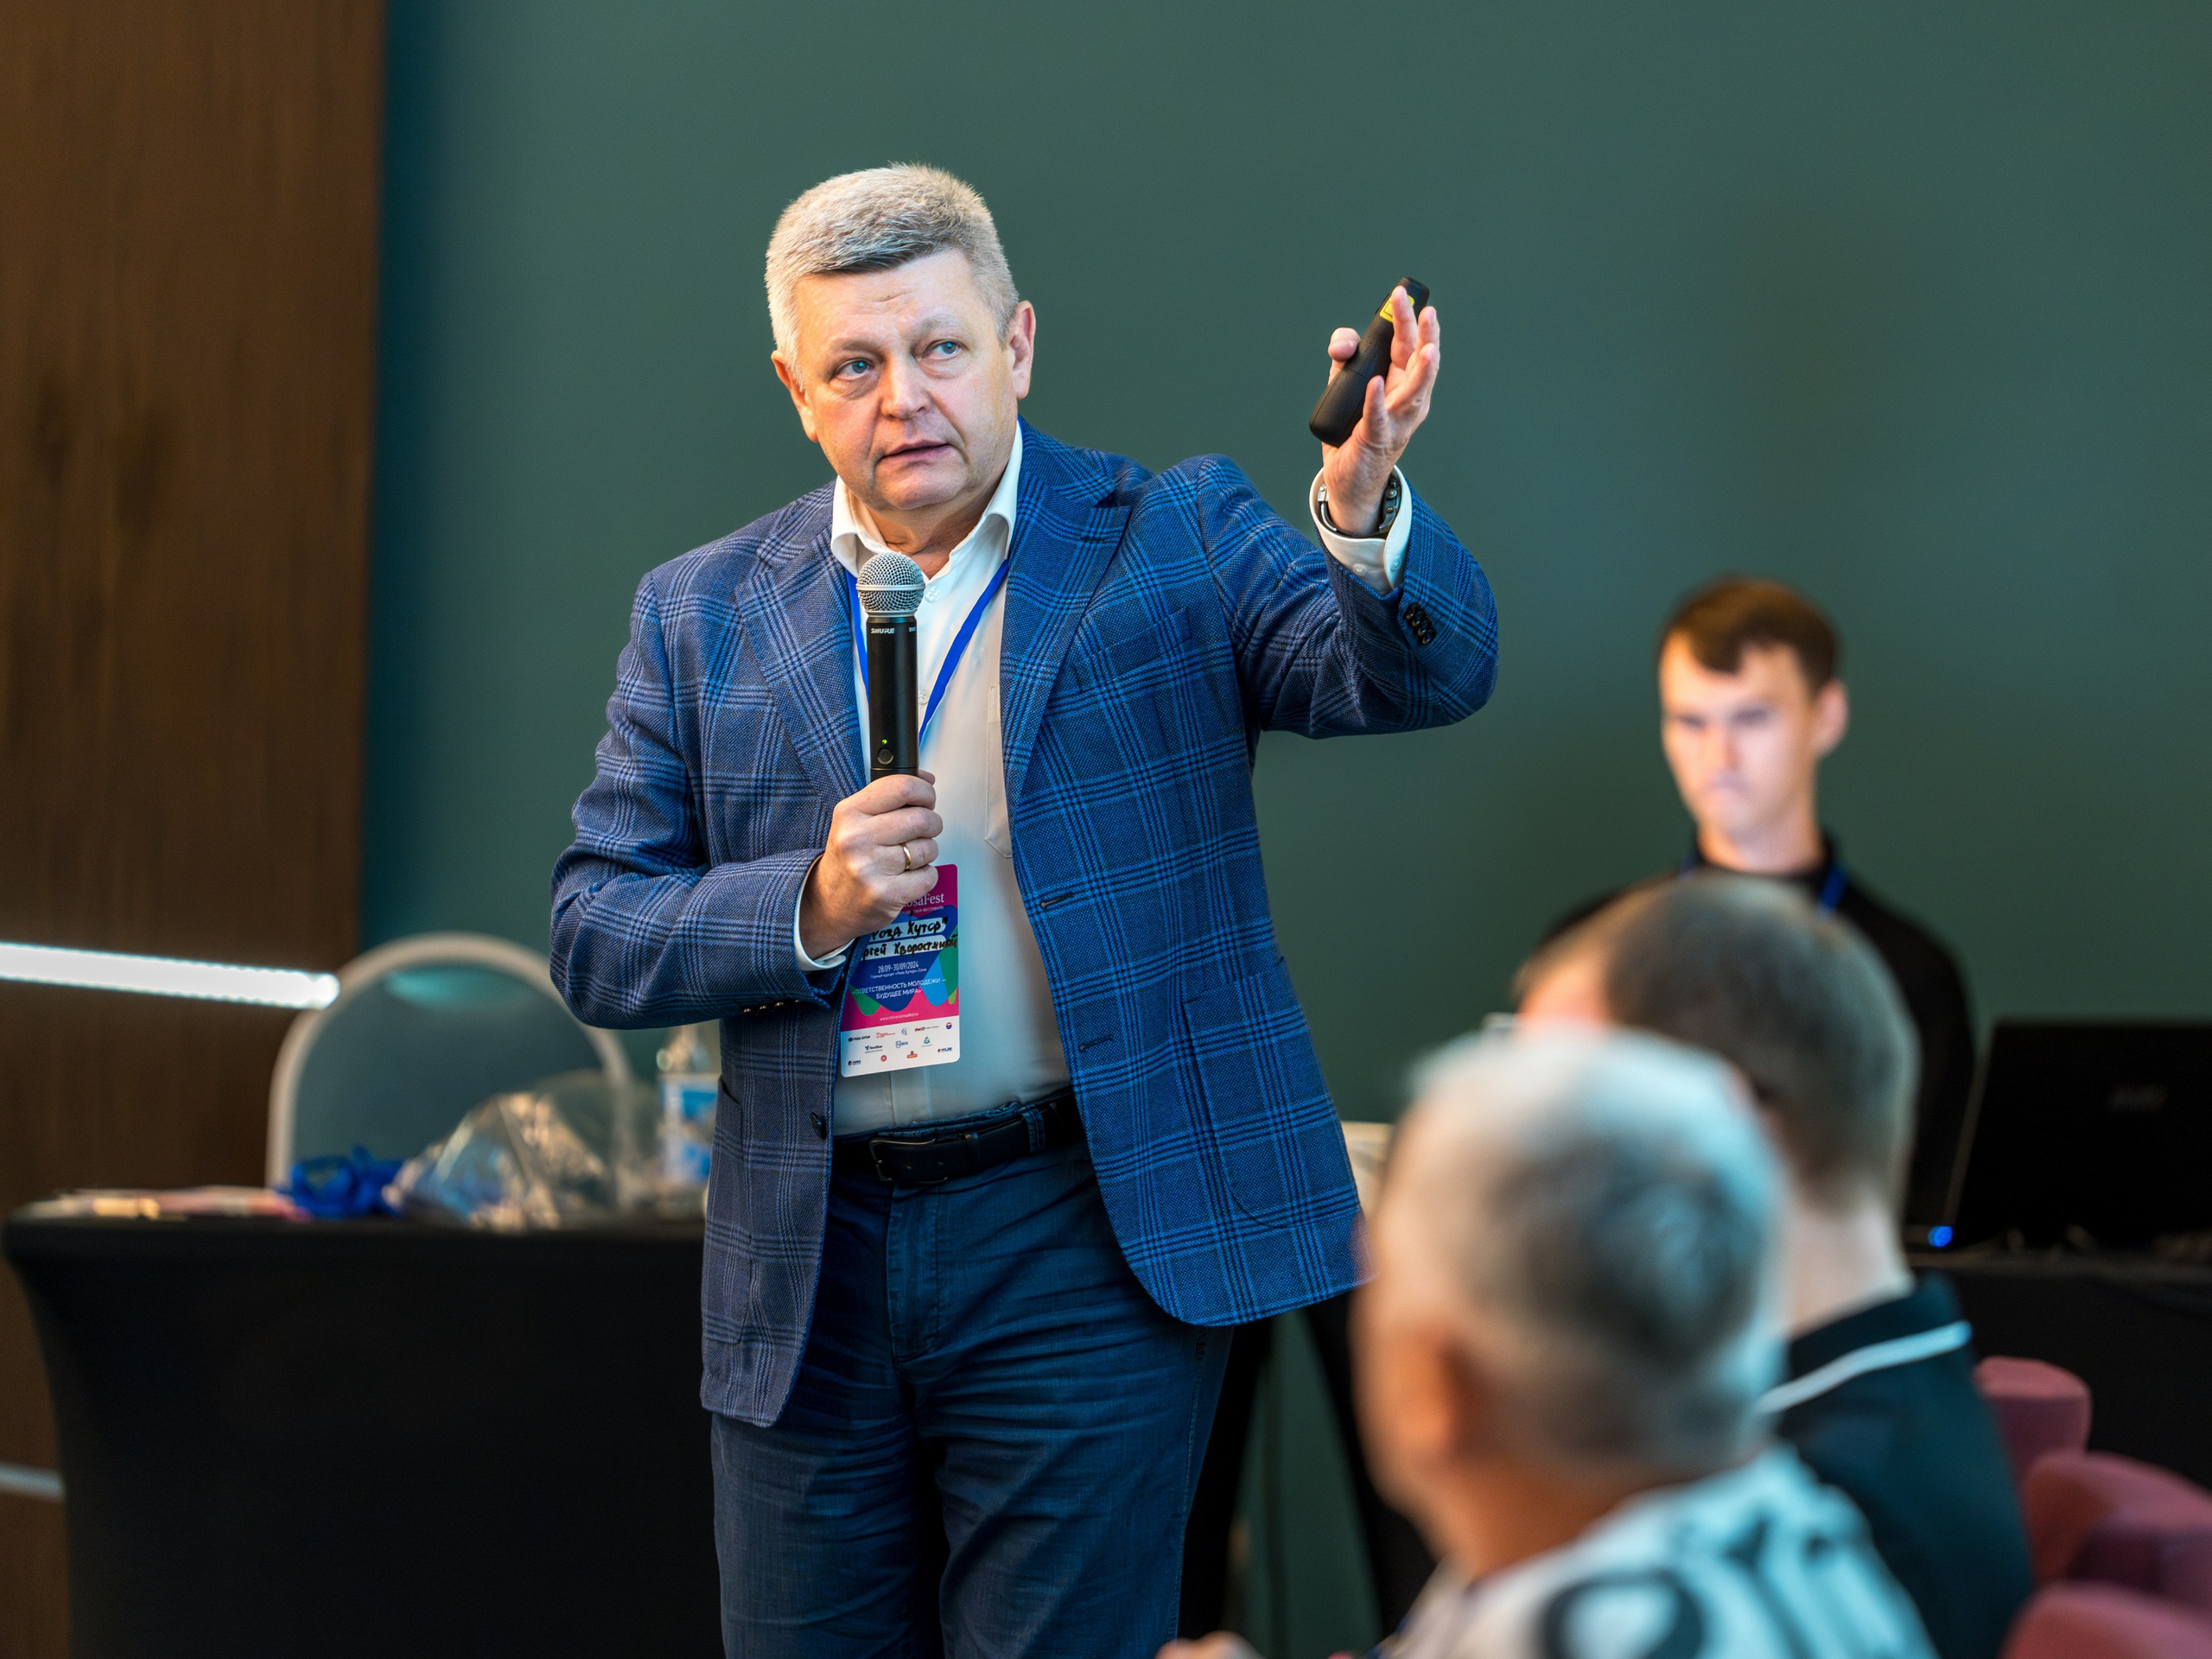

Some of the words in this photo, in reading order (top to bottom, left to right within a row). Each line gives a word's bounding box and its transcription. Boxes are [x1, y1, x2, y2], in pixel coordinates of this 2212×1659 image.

[904, 893, 944, 907] osaFest
[863, 944, 887, 959] ргей
[875, 989, 902, 1000] БУДУЩЕЕ
